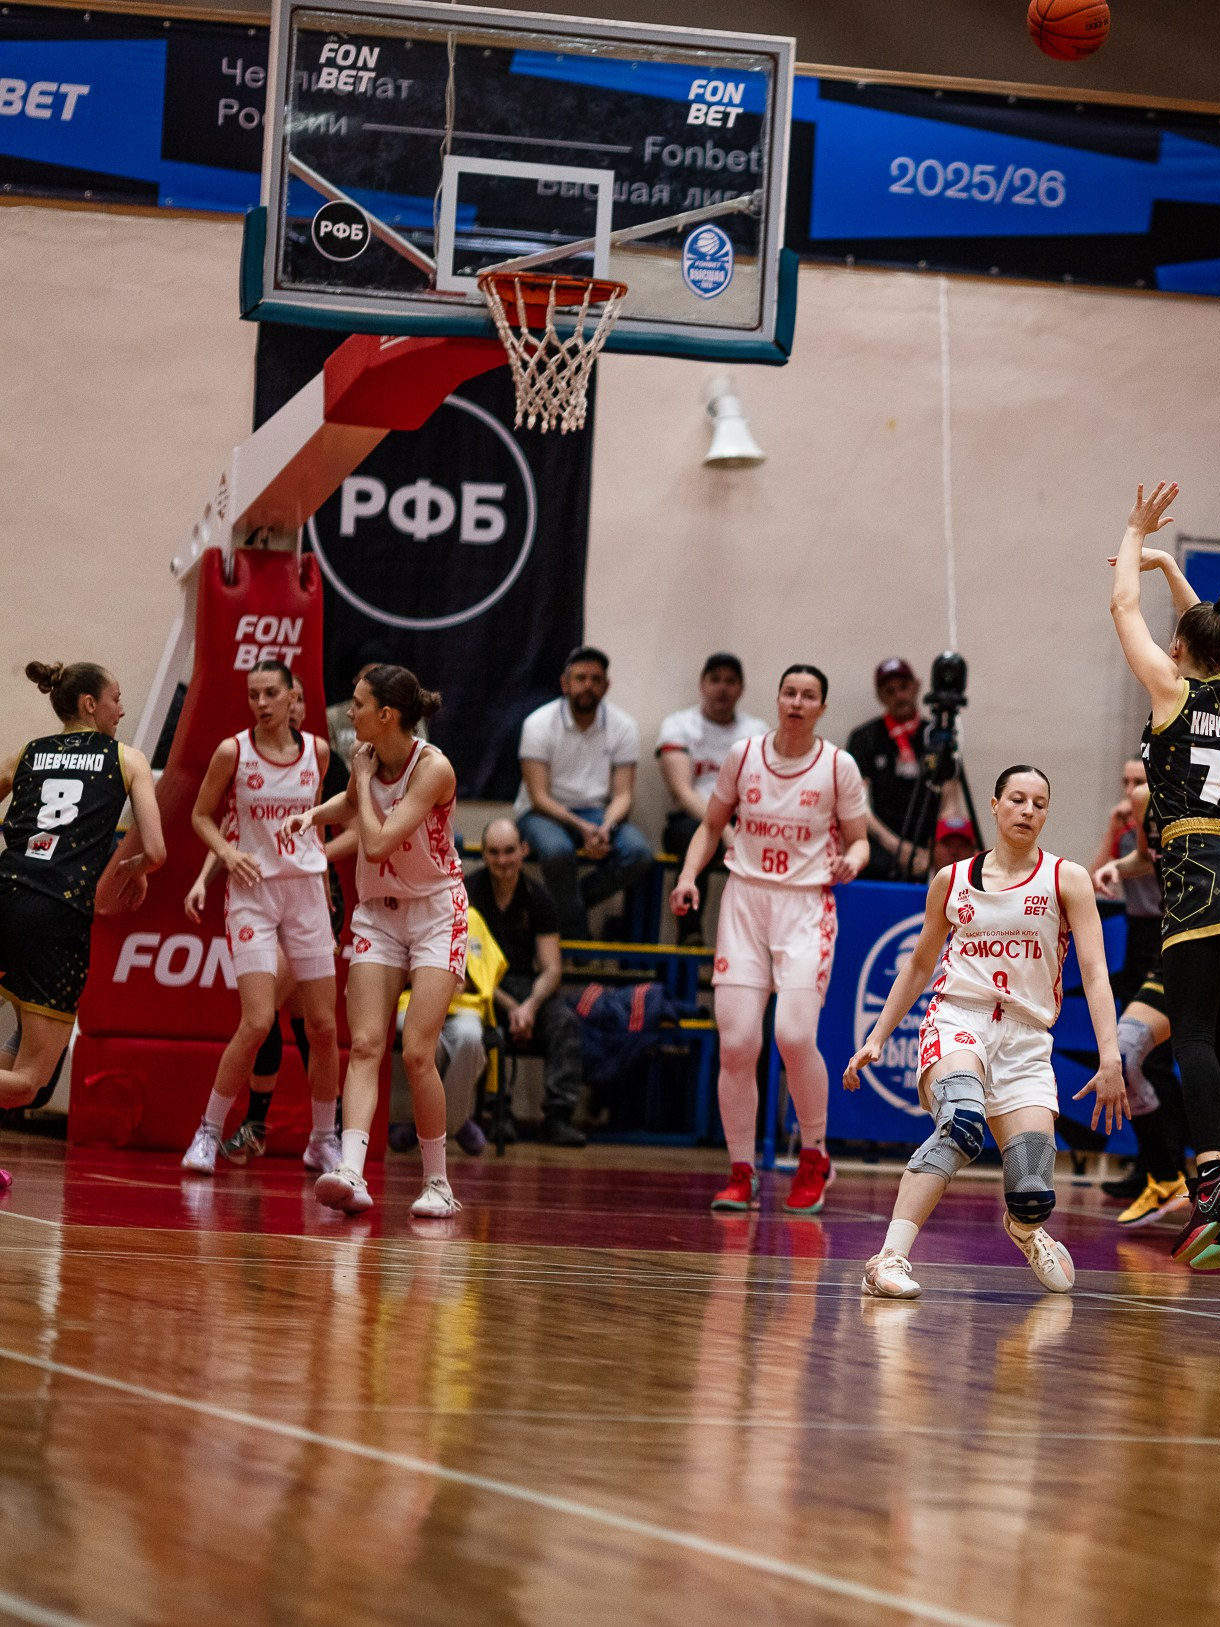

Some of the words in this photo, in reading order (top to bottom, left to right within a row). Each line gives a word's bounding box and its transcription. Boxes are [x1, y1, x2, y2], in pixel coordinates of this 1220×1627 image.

[318, 43, 380, 68] FON
[317, 67, 376, 93] BET
[688, 79, 745, 104] FON
[686, 103, 744, 128] BET
[643, 136, 763, 174] Fonbet
[889, 157, 1066, 208] 2025/26
[320, 220, 363, 240] РФБ
[340, 476, 507, 545] РФБ
[234, 614, 304, 645] FON
[32, 753, 105, 772] ШЕВЧЕНКО
[37, 778, 84, 831] 8
[249, 803, 312, 822] ЮНОСТ
[746, 818, 812, 843] ЮНОСТЬ
[761, 848, 789, 875] 58
[1024, 895, 1049, 906] FON
[1024, 905, 1048, 916] BET
[960, 939, 1043, 959] ЮНОСТЬ
